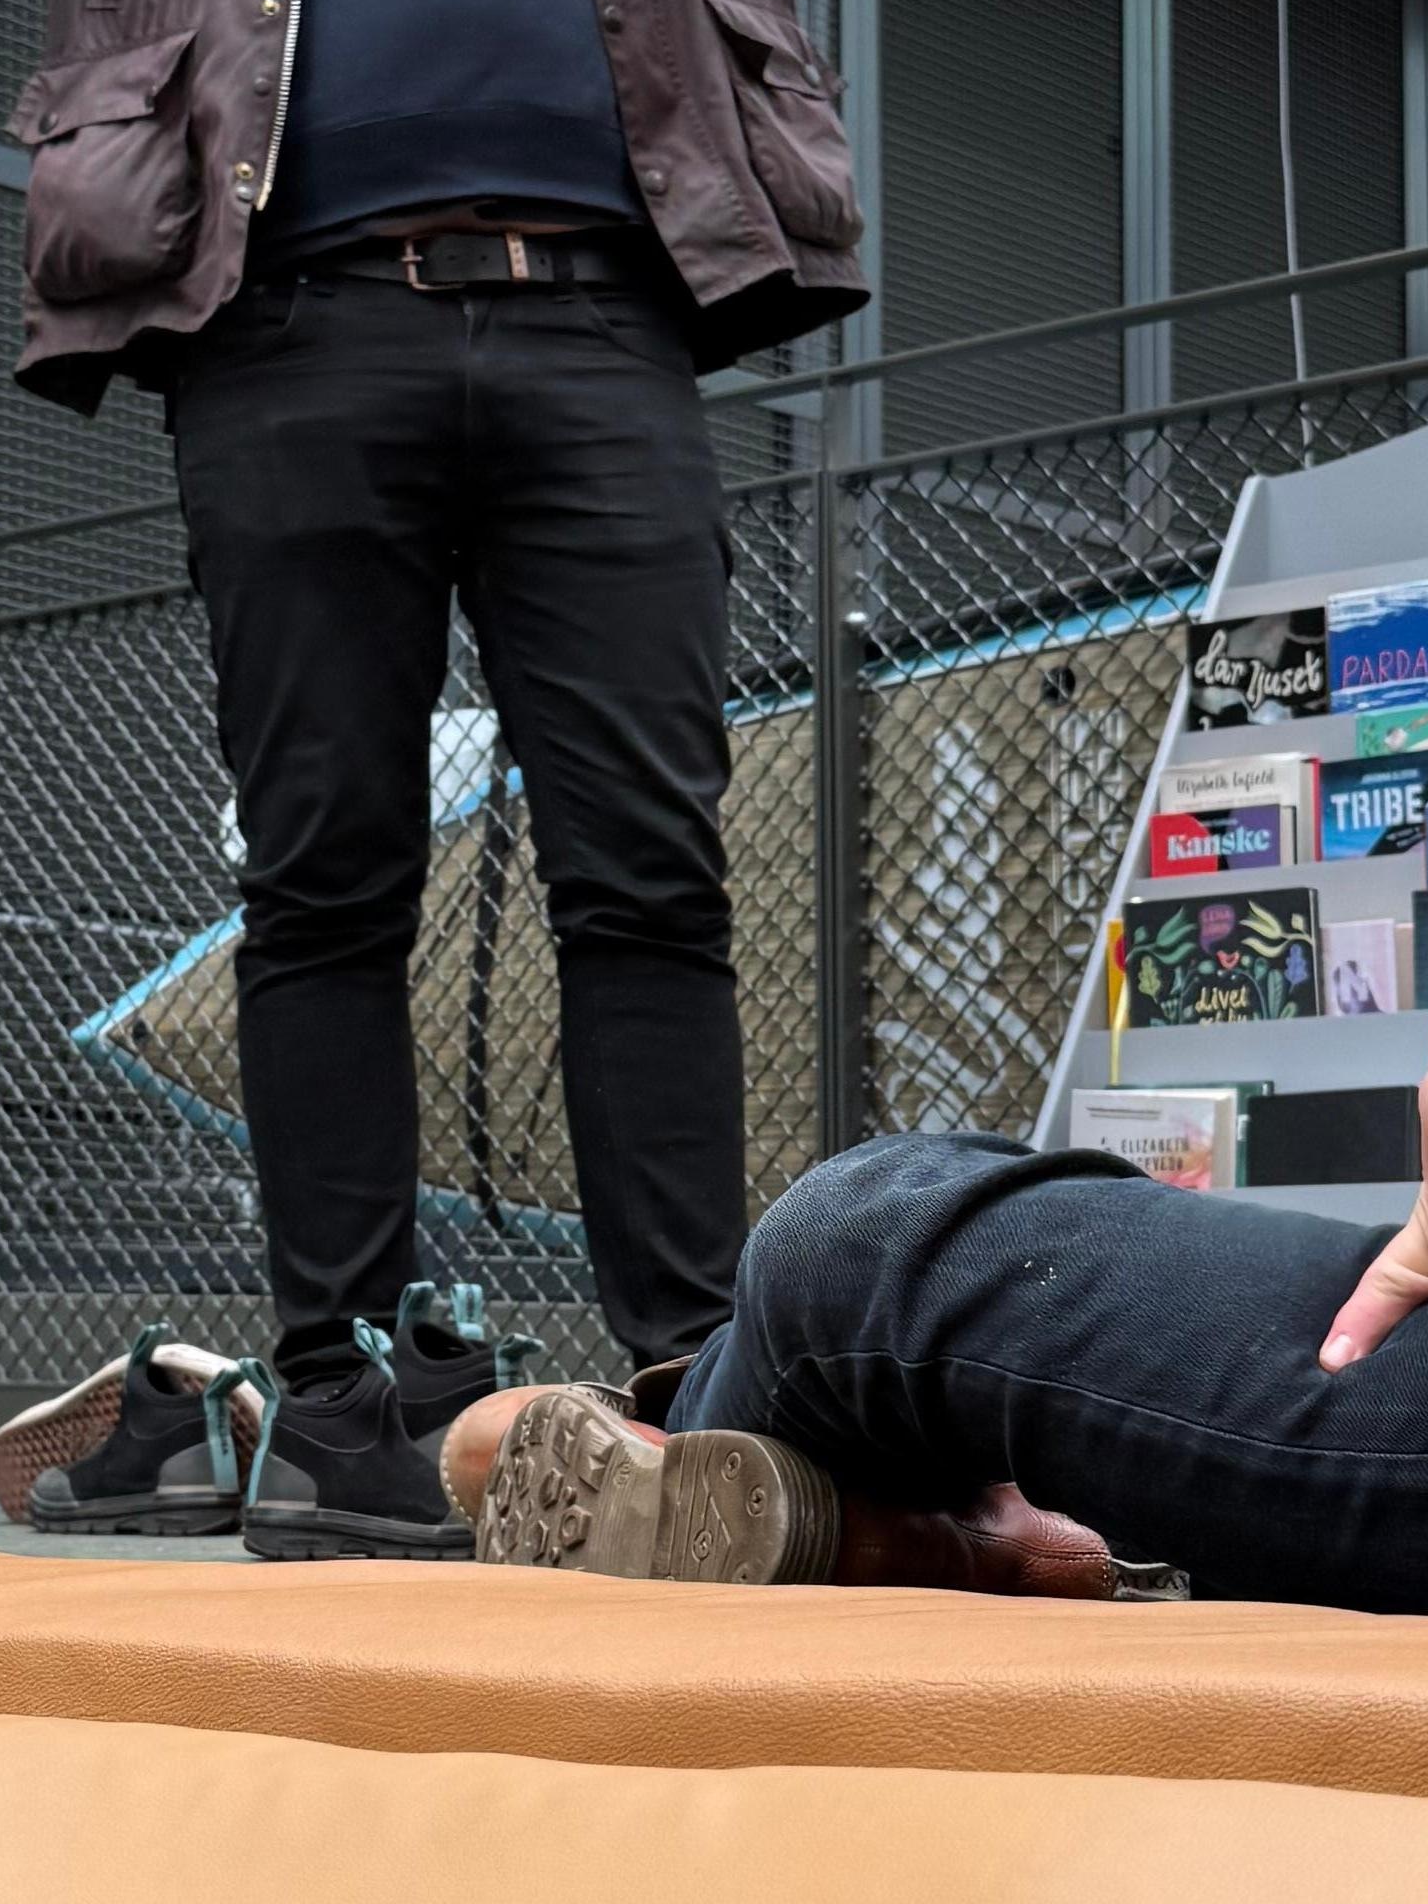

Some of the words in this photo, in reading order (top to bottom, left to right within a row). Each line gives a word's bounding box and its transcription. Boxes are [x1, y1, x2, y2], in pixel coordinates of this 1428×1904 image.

[1246, 650, 1323, 709] ljuset
[1167, 825, 1271, 861] Kanske
[1121, 1137, 1189, 1154] ELIZABETH
[1131, 1156, 1184, 1172] EVEDO
